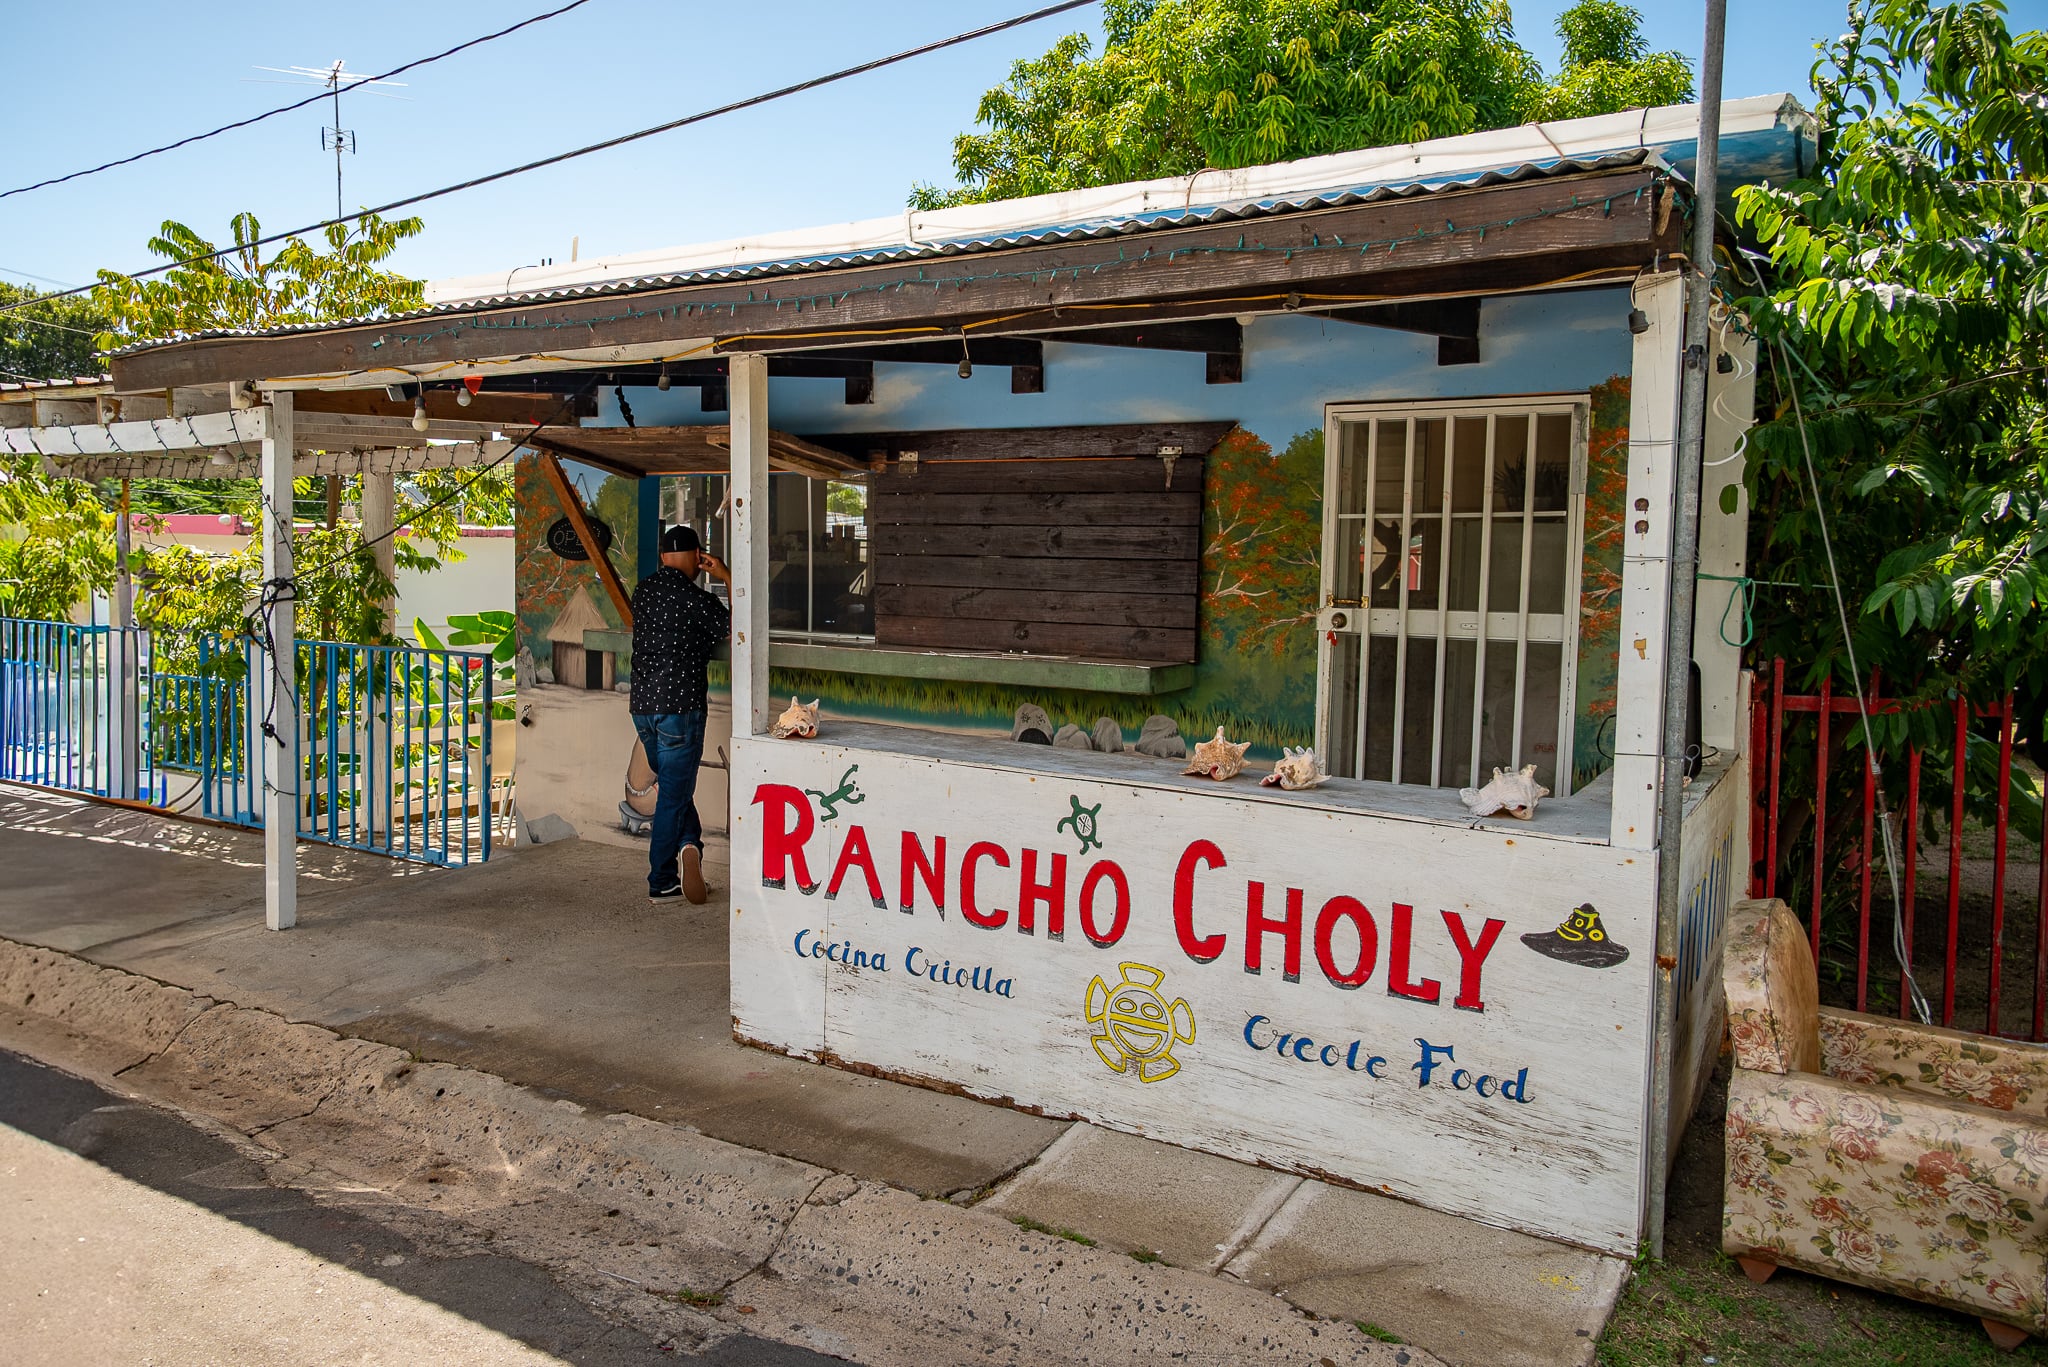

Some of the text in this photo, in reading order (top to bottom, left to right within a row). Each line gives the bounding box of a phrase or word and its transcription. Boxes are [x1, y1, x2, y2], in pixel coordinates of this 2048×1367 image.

[553, 526, 602, 547] OP
[751, 783, 1130, 949] RANCHO
[1173, 839, 1507, 1014] CHOLY
[794, 929, 1016, 999] Cocina Criolla
[1243, 1011, 1535, 1104] Creole Food
